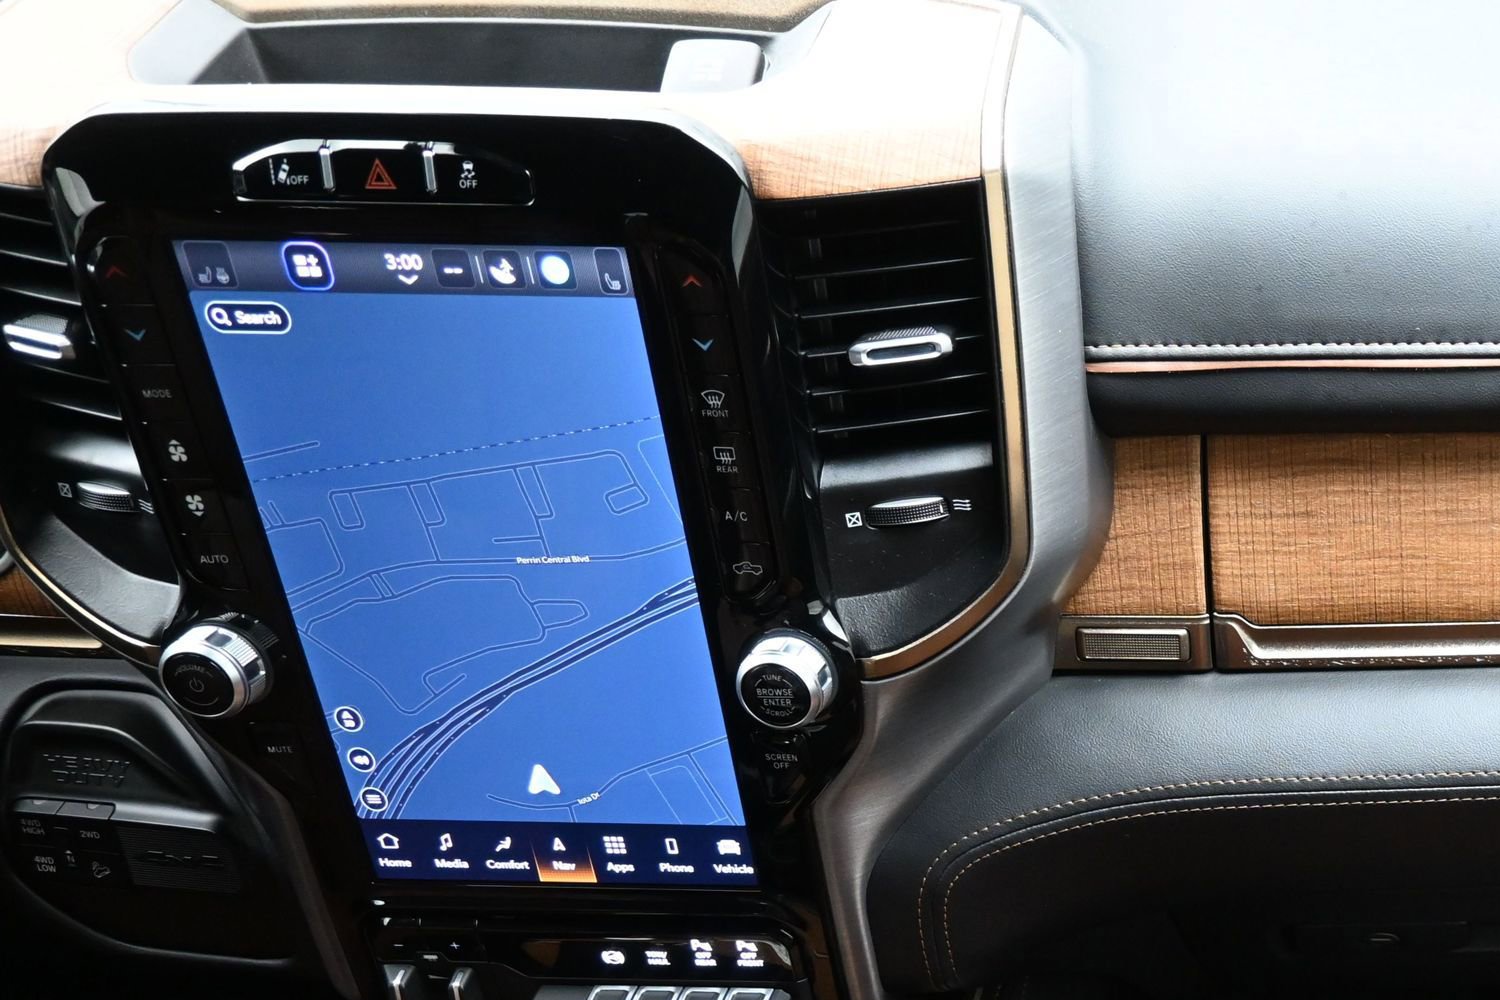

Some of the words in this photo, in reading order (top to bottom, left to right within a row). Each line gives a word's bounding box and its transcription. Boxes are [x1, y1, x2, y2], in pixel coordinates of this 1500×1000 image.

[290, 175, 309, 185] OFF
[459, 179, 478, 189] OFF
[383, 252, 423, 270] 3:00
[234, 311, 282, 325] Search
[142, 389, 172, 398] MODE
[702, 410, 729, 418] FRONT
[725, 511, 748, 521] A/C
[200, 555, 229, 564] AUTO
[541, 556, 571, 564] Central
[572, 555, 590, 563] Blvd
[756, 688, 793, 696] BROWSE
[765, 753, 798, 762] SCREEN
[80, 830, 101, 839] 2WD
[36, 863, 57, 873] LOW
[378, 858, 412, 868] Home
[434, 859, 469, 869] Media
[486, 859, 530, 870] Comfort
[553, 861, 576, 871] Nav
[607, 862, 635, 873] Apps
[659, 863, 694, 873] Phone
[713, 864, 754, 874] Vehicle
